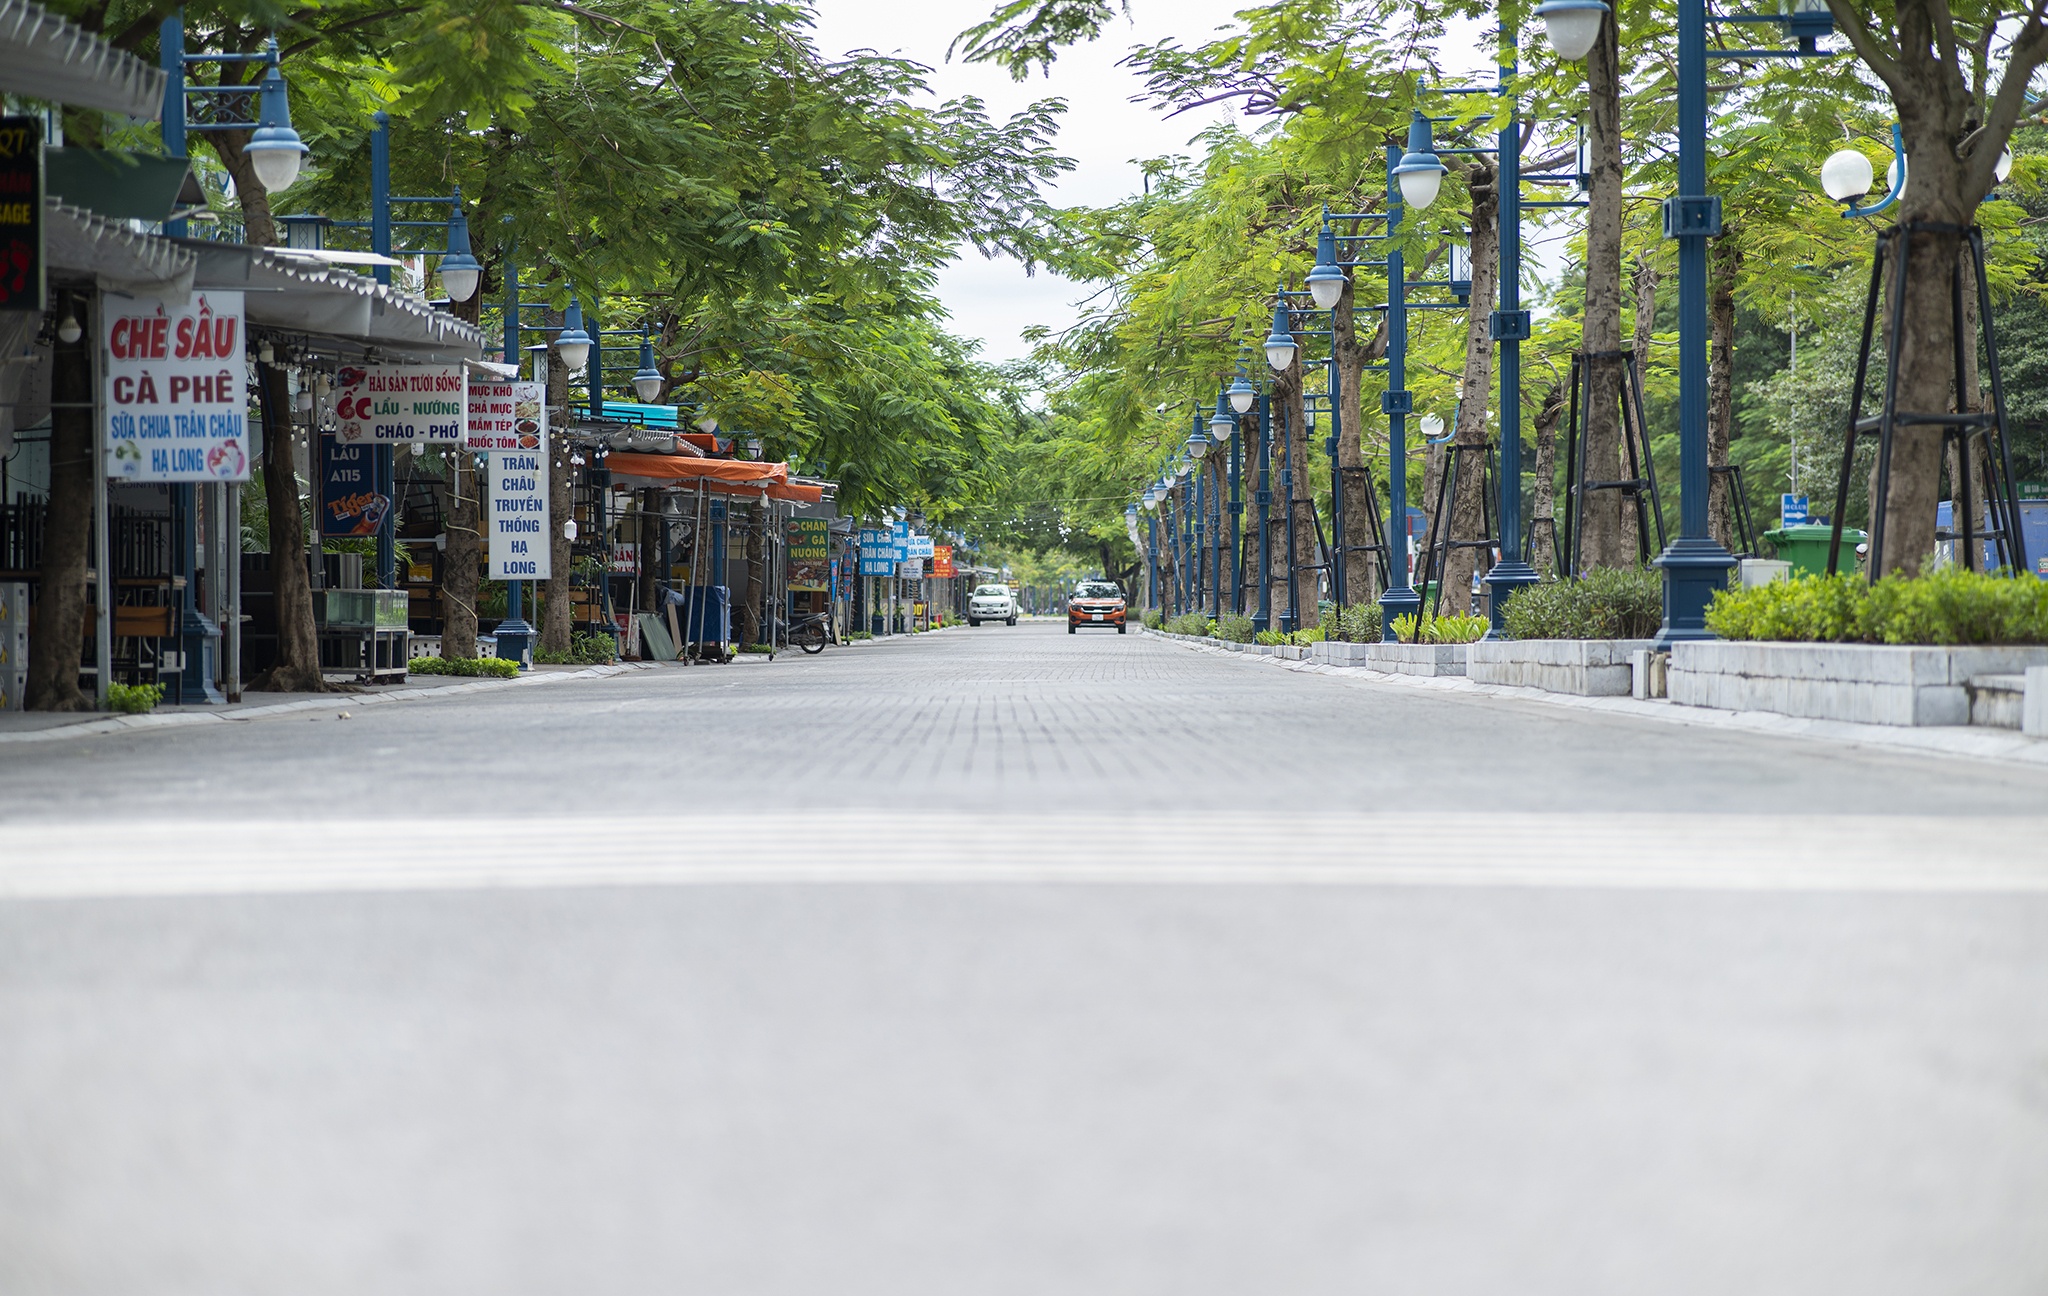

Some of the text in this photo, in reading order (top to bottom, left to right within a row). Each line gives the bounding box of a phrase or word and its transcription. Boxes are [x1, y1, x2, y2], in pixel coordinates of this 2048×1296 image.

[110, 295, 238, 360] CHÈ SẦU
[113, 369, 235, 405] CÀ PHÊ
[368, 368, 462, 392] HẢI SẢN TƯƠI SỐNG
[468, 384, 513, 399] MỰC KHÔ
[413, 399, 460, 415] NƯỚNG
[468, 400, 512, 416] CHẢ MỰC
[111, 408, 243, 439] SỮA CHUA TRÂN CHÂU
[375, 421, 415, 439] CHÁO
[429, 420, 460, 439] PHỞ
[495, 418, 513, 431] TÉP
[467, 433, 517, 449] RUỐC TÔM
[152, 448, 169, 478] HẠ
[172, 448, 204, 473] LONG
[502, 454, 535, 470] TRÂN
[330, 468, 361, 482] A115
[502, 475, 535, 491] CHÂU
[327, 491, 374, 517] Tiger
[499, 515, 540, 533] THỐNG
[511, 541, 528, 556] HẠ
[503, 561, 536, 575] LONG
